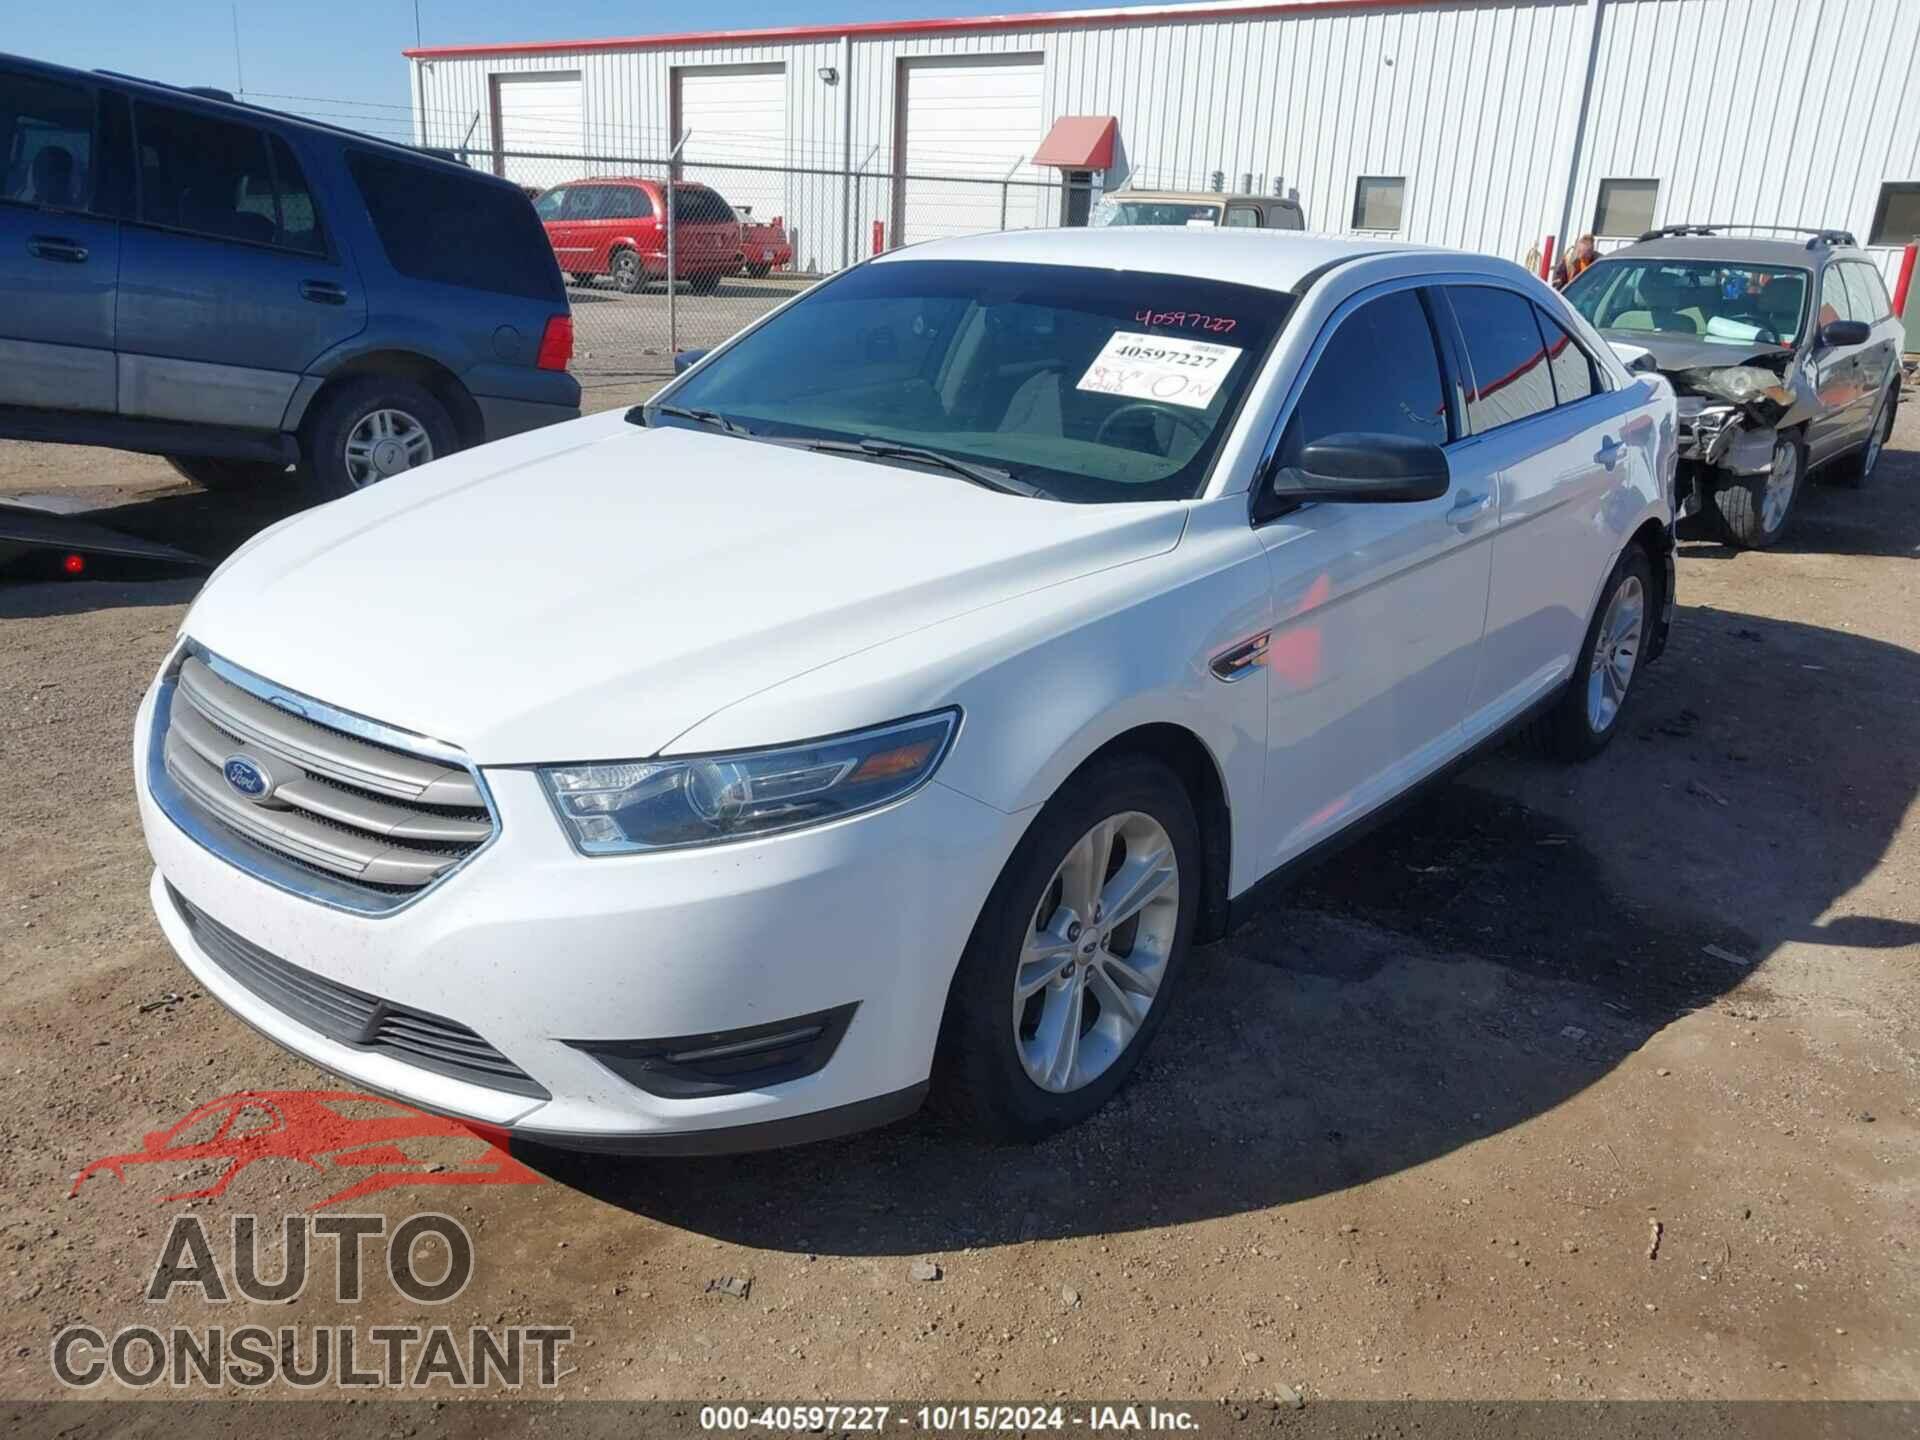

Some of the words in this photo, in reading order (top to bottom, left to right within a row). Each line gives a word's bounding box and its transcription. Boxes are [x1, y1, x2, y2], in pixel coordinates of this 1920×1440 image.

[1135, 310, 1237, 332] 40597227
[1115, 345, 1219, 369] 40597227
[230, 763, 257, 791] Ford
